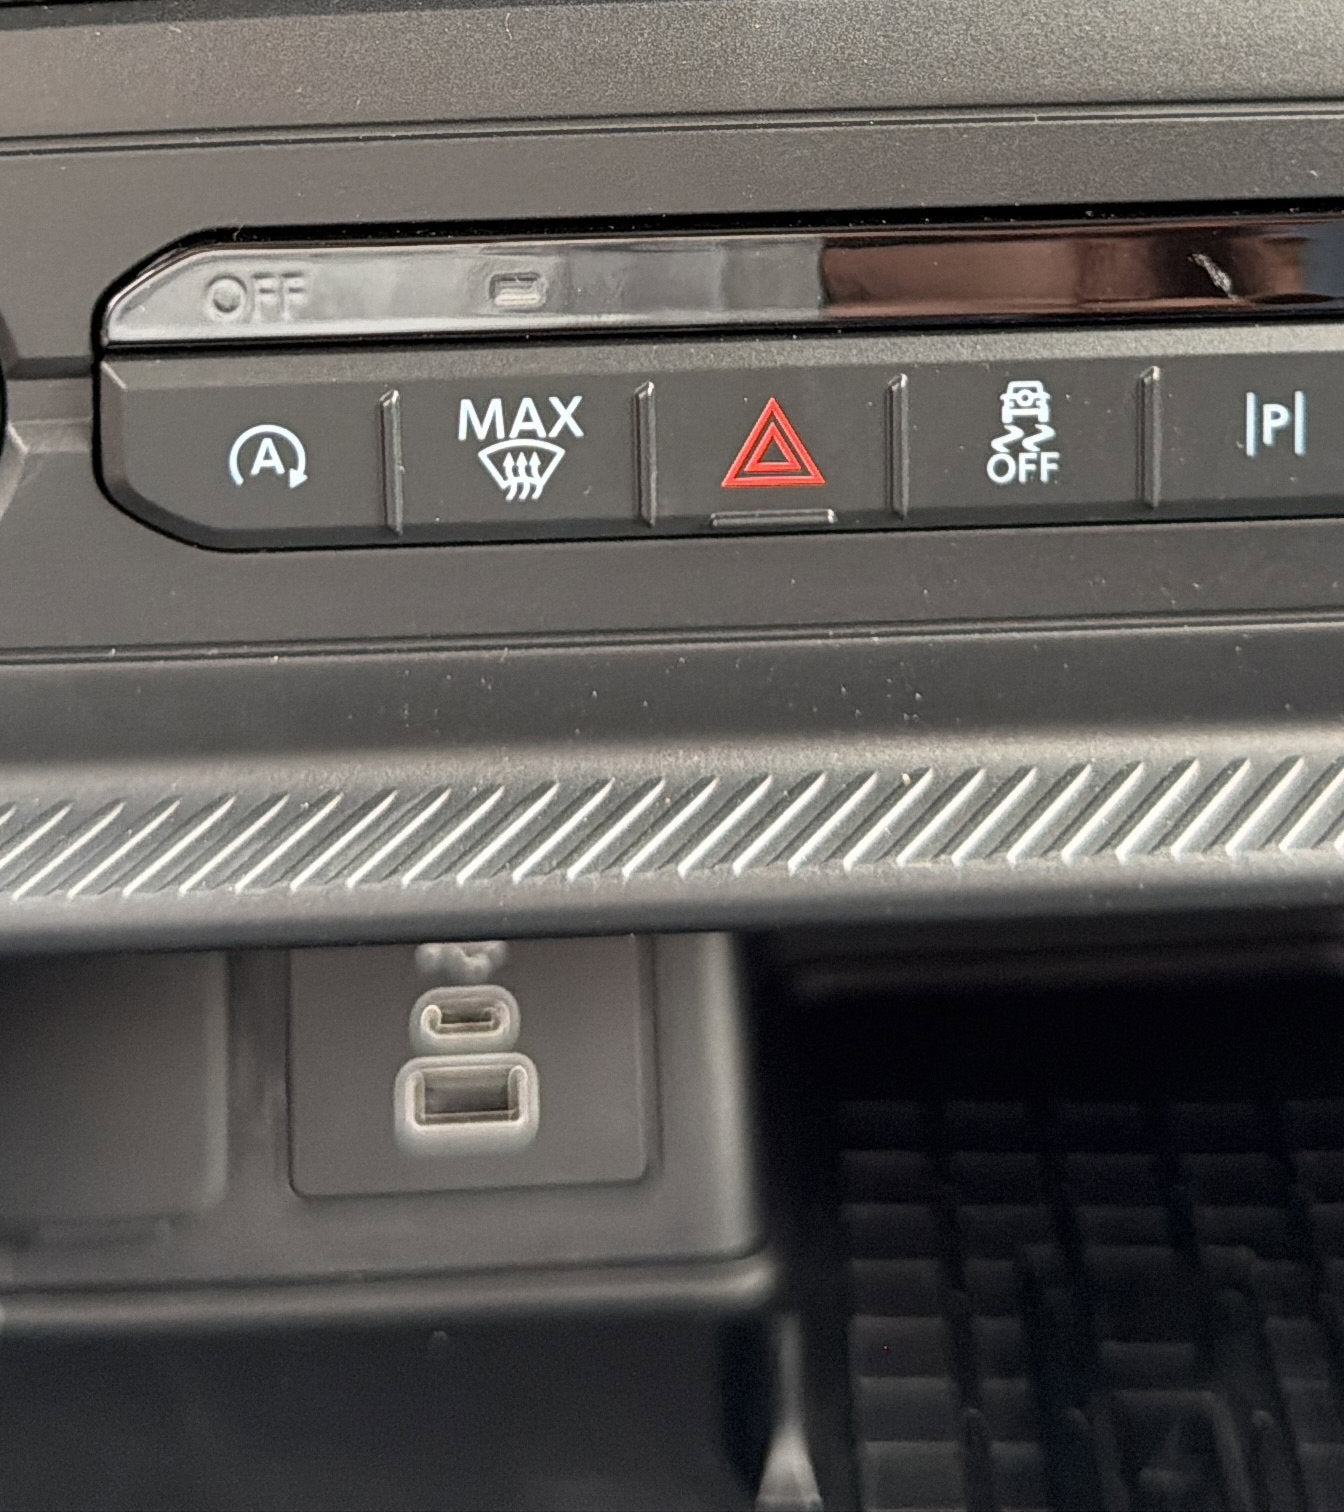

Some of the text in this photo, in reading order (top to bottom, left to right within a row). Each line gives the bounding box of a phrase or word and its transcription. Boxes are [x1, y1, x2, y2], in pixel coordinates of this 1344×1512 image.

[206, 272, 310, 322] OFF
[458, 395, 586, 441] MAX
[250, 439, 285, 476] A
[986, 451, 1062, 485] OFF
